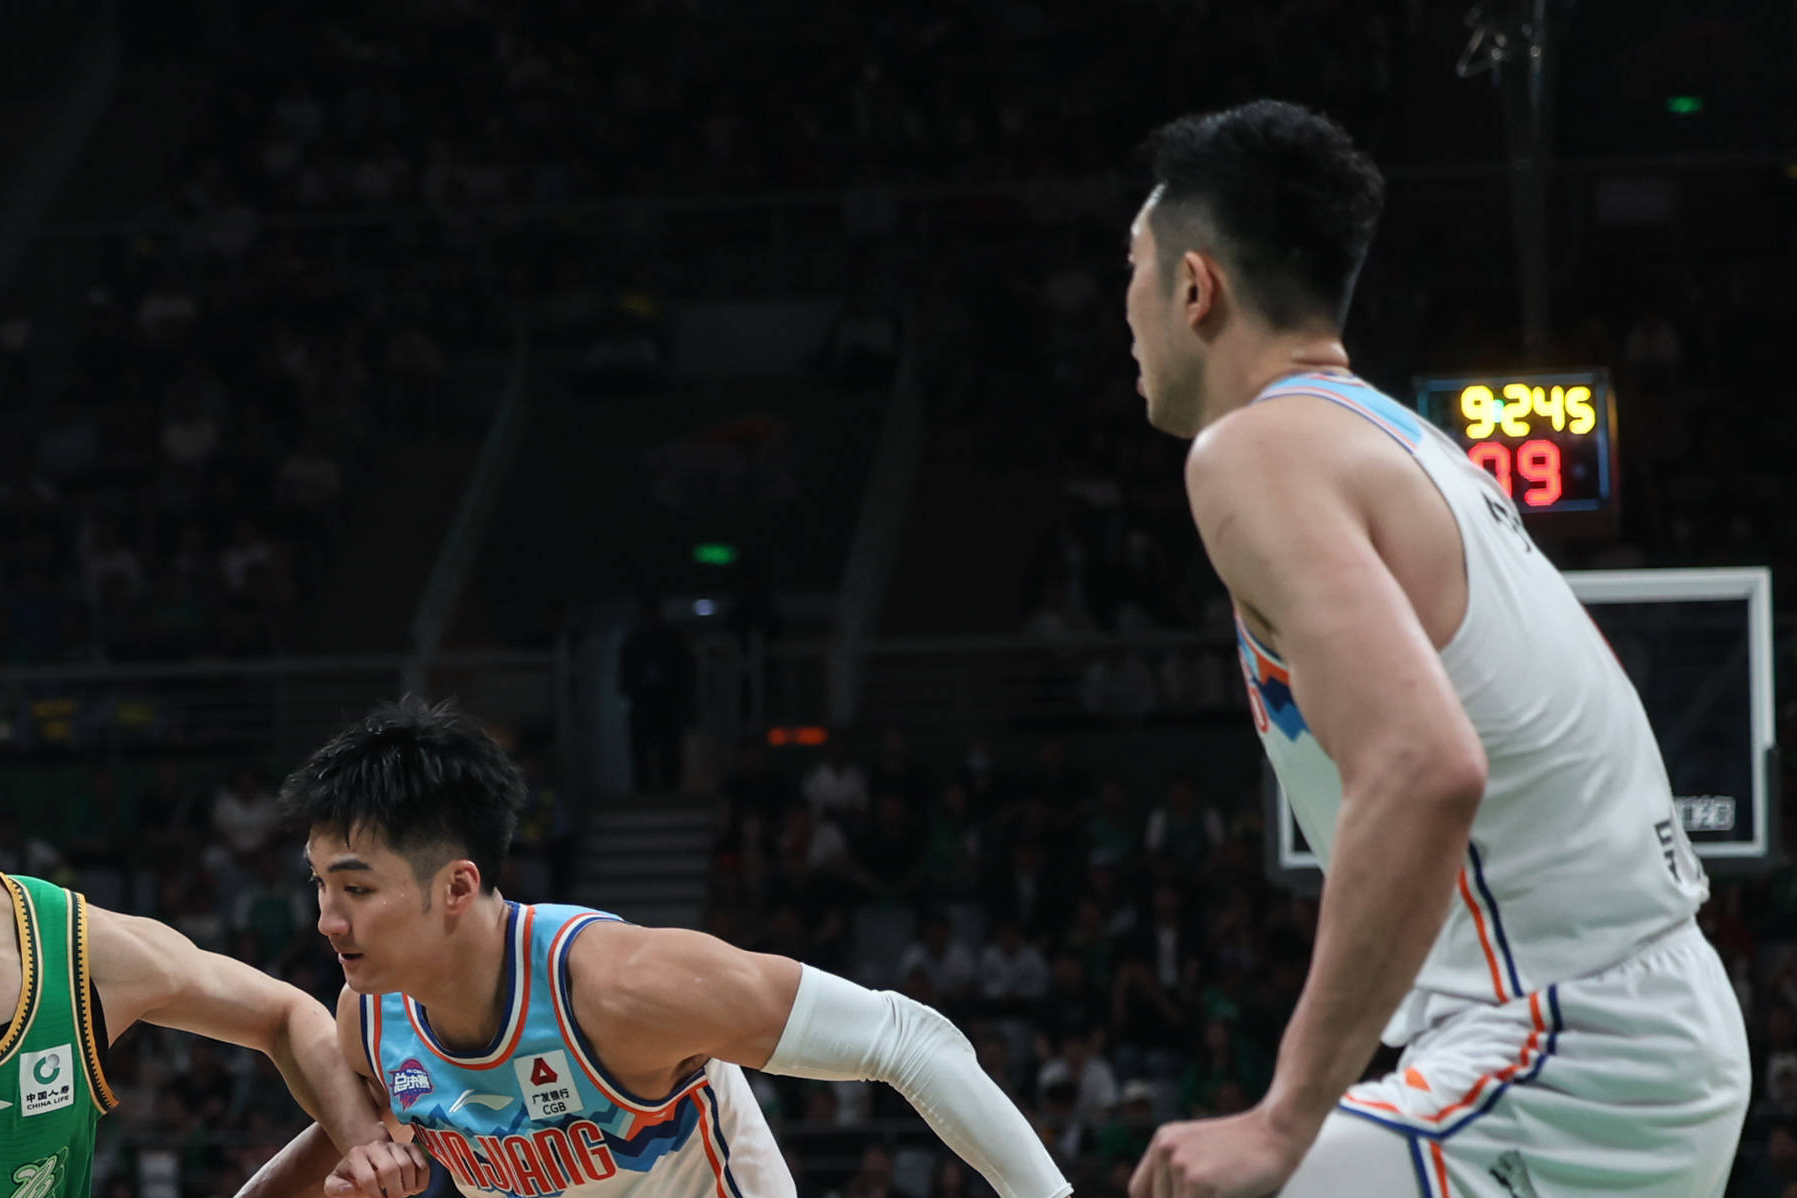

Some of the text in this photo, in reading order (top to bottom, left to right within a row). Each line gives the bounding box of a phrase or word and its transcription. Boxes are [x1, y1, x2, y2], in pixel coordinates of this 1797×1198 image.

[26, 1094, 70, 1111] CHINA LIFE
[542, 1101, 567, 1115] CGB
